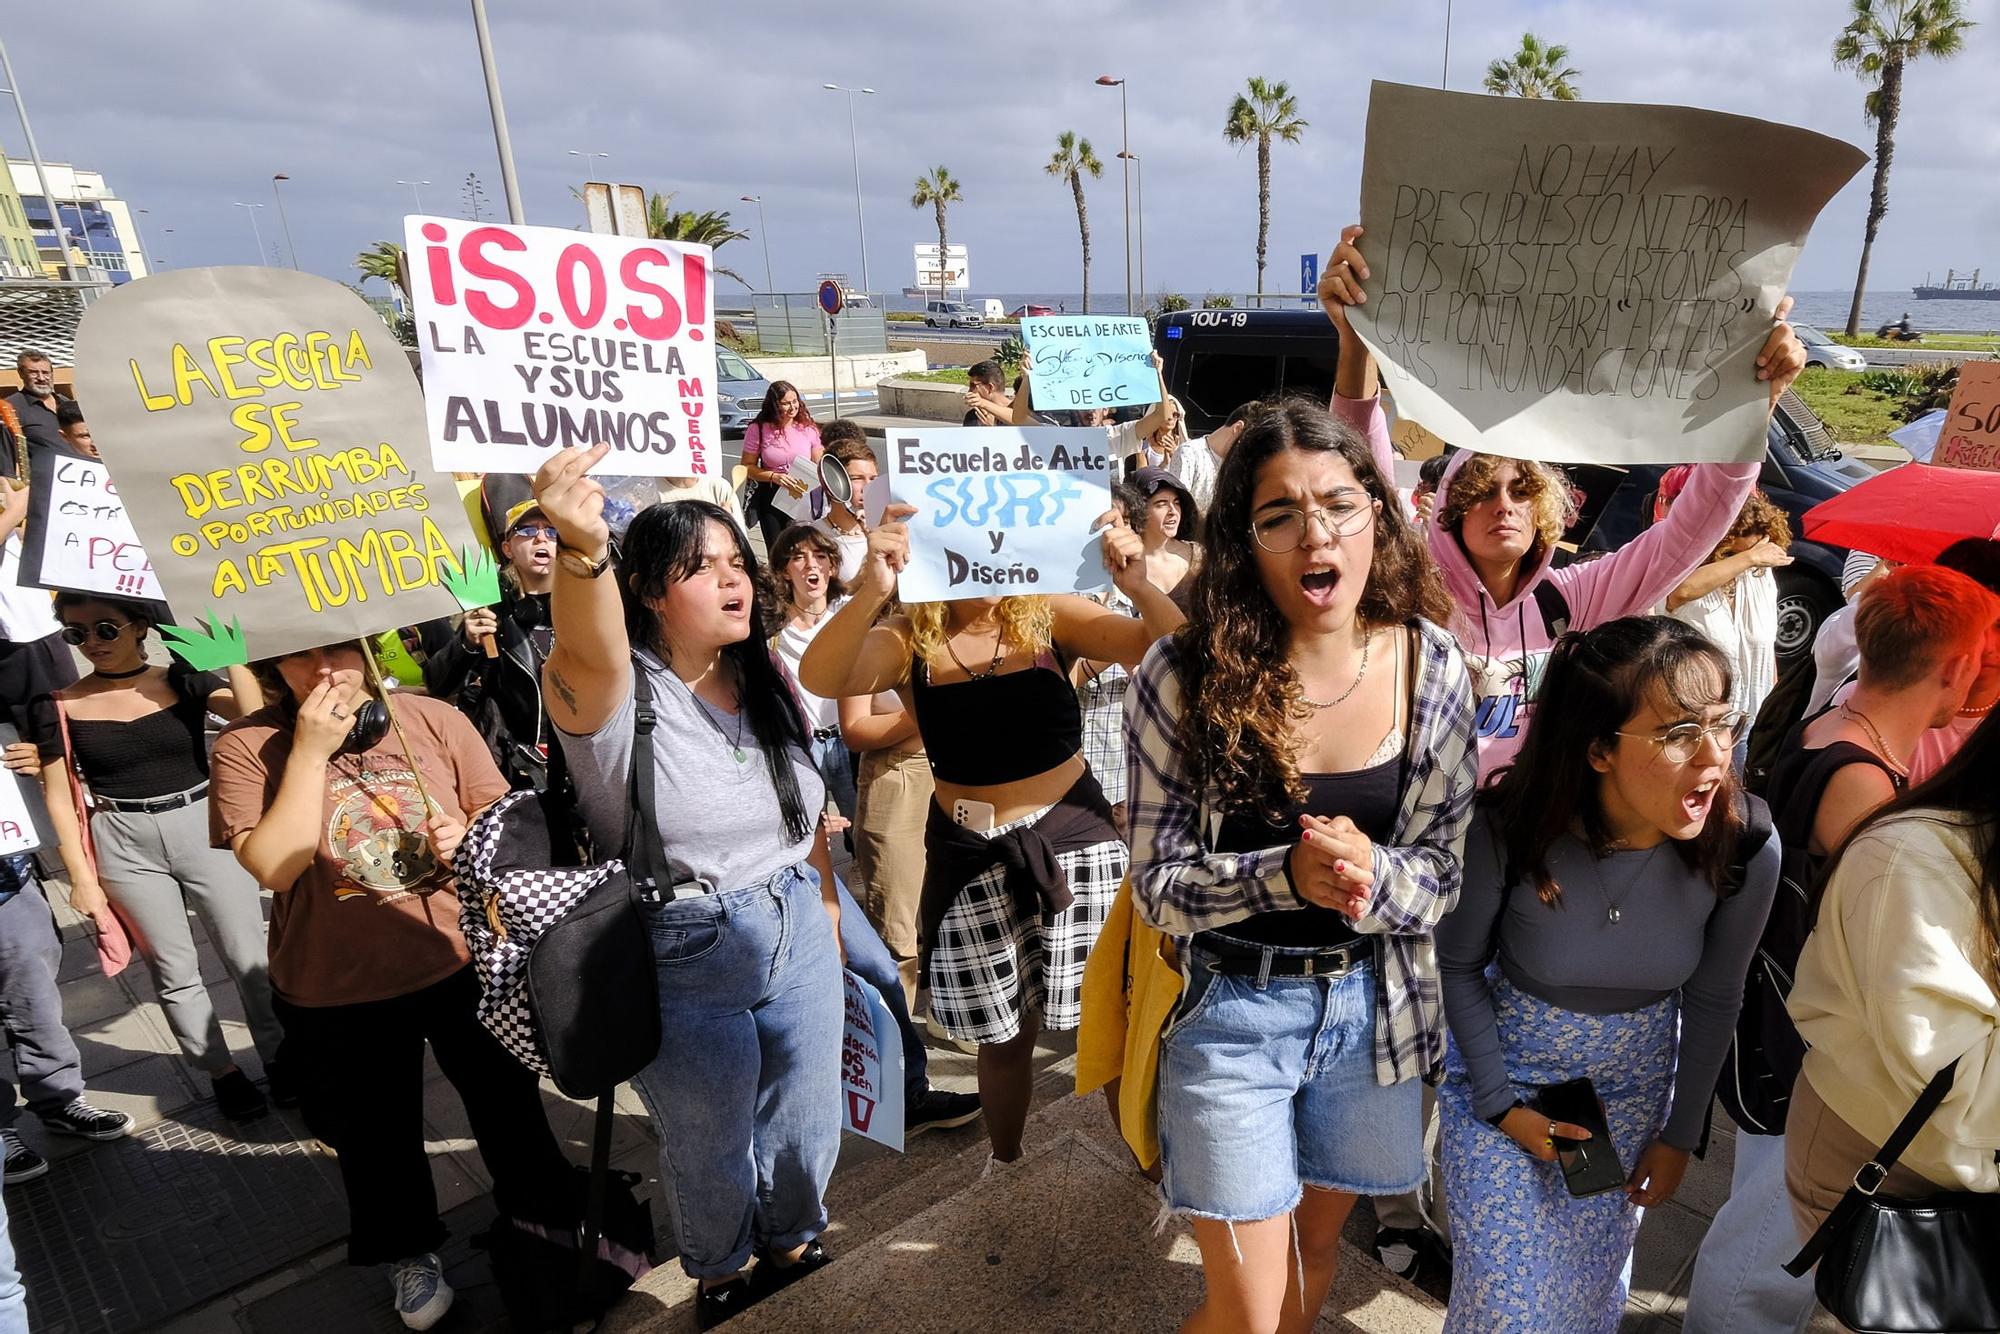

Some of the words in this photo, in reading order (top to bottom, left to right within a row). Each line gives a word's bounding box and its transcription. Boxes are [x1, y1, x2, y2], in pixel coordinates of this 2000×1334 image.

[1512, 144, 1572, 196] NO
[1577, 144, 1675, 195] HAY
[1388, 185, 1624, 246] PRESUPUESTO
[1627, 194, 1686, 250] NI
[1682, 197, 1749, 252] PARA
[1384, 241, 1443, 294] LOS
[1453, 243, 1580, 296] TRISTES
[1593, 243, 1746, 302] CARTONES
[1030, 323, 1091, 338] ESCUELA
[1095, 324, 1112, 336] DE
[1112, 323, 1142, 335] ARTE
[1376, 291, 1431, 347] QUE
[1445, 291, 1541, 346] PONEN
[1544, 293, 1611, 349] PARA
[129, 343, 219, 412] LA
[208, 329, 372, 400] ESCUELA
[429, 321, 485, 355] LA
[524, 331, 686, 375] ESCUELA
[1386, 342, 1438, 388] LAS
[1458, 343, 1724, 400] INUNDACIONES
[514, 364, 543, 393] Y
[550, 365, 624, 403] SUS
[1070, 388, 1093, 405] DE
[1098, 384, 1129, 402] GC
[231, 402, 320, 453] SE
[443, 395, 677, 455] ALUMNOS
[678, 378, 707, 475] MUEREN
[57, 462, 96, 486] LA
[897, 438, 1008, 475] Escuela
[1013, 444, 1044, 471] de
[1047, 444, 1106, 471] Arte
[925, 472, 1084, 528] SURF
[64, 532, 79, 547] A
[256, 515, 465, 613] TUMBA
[988, 530, 1005, 554] y
[212, 558, 247, 598] A
[247, 554, 287, 587] LA
[944, 547, 1040, 587] Diseño
